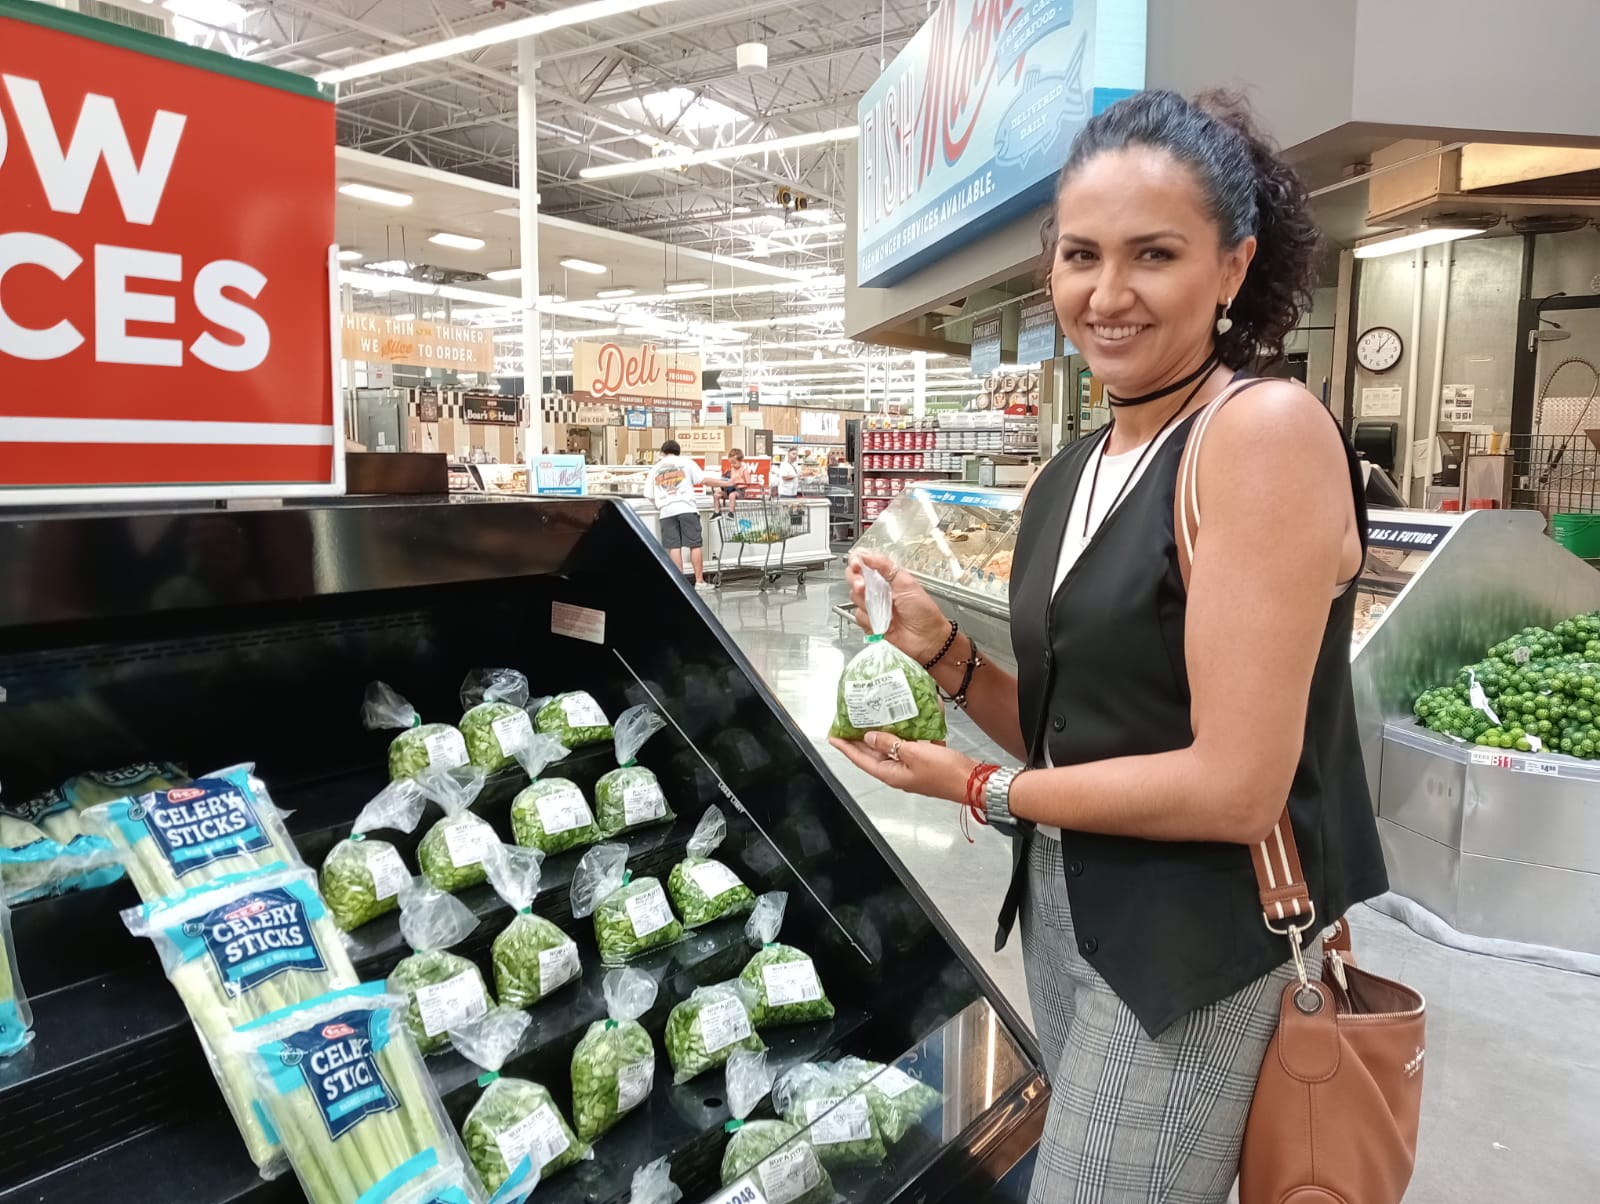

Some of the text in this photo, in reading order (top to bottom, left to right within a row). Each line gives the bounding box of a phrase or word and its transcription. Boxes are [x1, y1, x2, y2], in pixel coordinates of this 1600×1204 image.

[1013, 9, 1056, 52] SEAFOOD
[1010, 85, 1063, 129] DELIVERED
[1020, 114, 1048, 140] DAILY
[902, 209, 939, 247] SERVICES
[940, 171, 995, 222] AVAILABLE.
[360, 337, 379, 353] WE
[418, 343, 432, 358] TO
[436, 347, 477, 363] ORDER.
[385, 319, 414, 336] THIN
[436, 326, 488, 344] THINNER.
[592, 343, 660, 394] Deli
[693, 432, 721, 440] DELI
[1388, 530, 1397, 541] A
[1396, 531, 1438, 545] FUTURE
[154, 790, 236, 828] CELERY
[166, 811, 247, 847] STICKS
[212, 902, 298, 943] CELERY
[224, 926, 304, 963] STICKS
